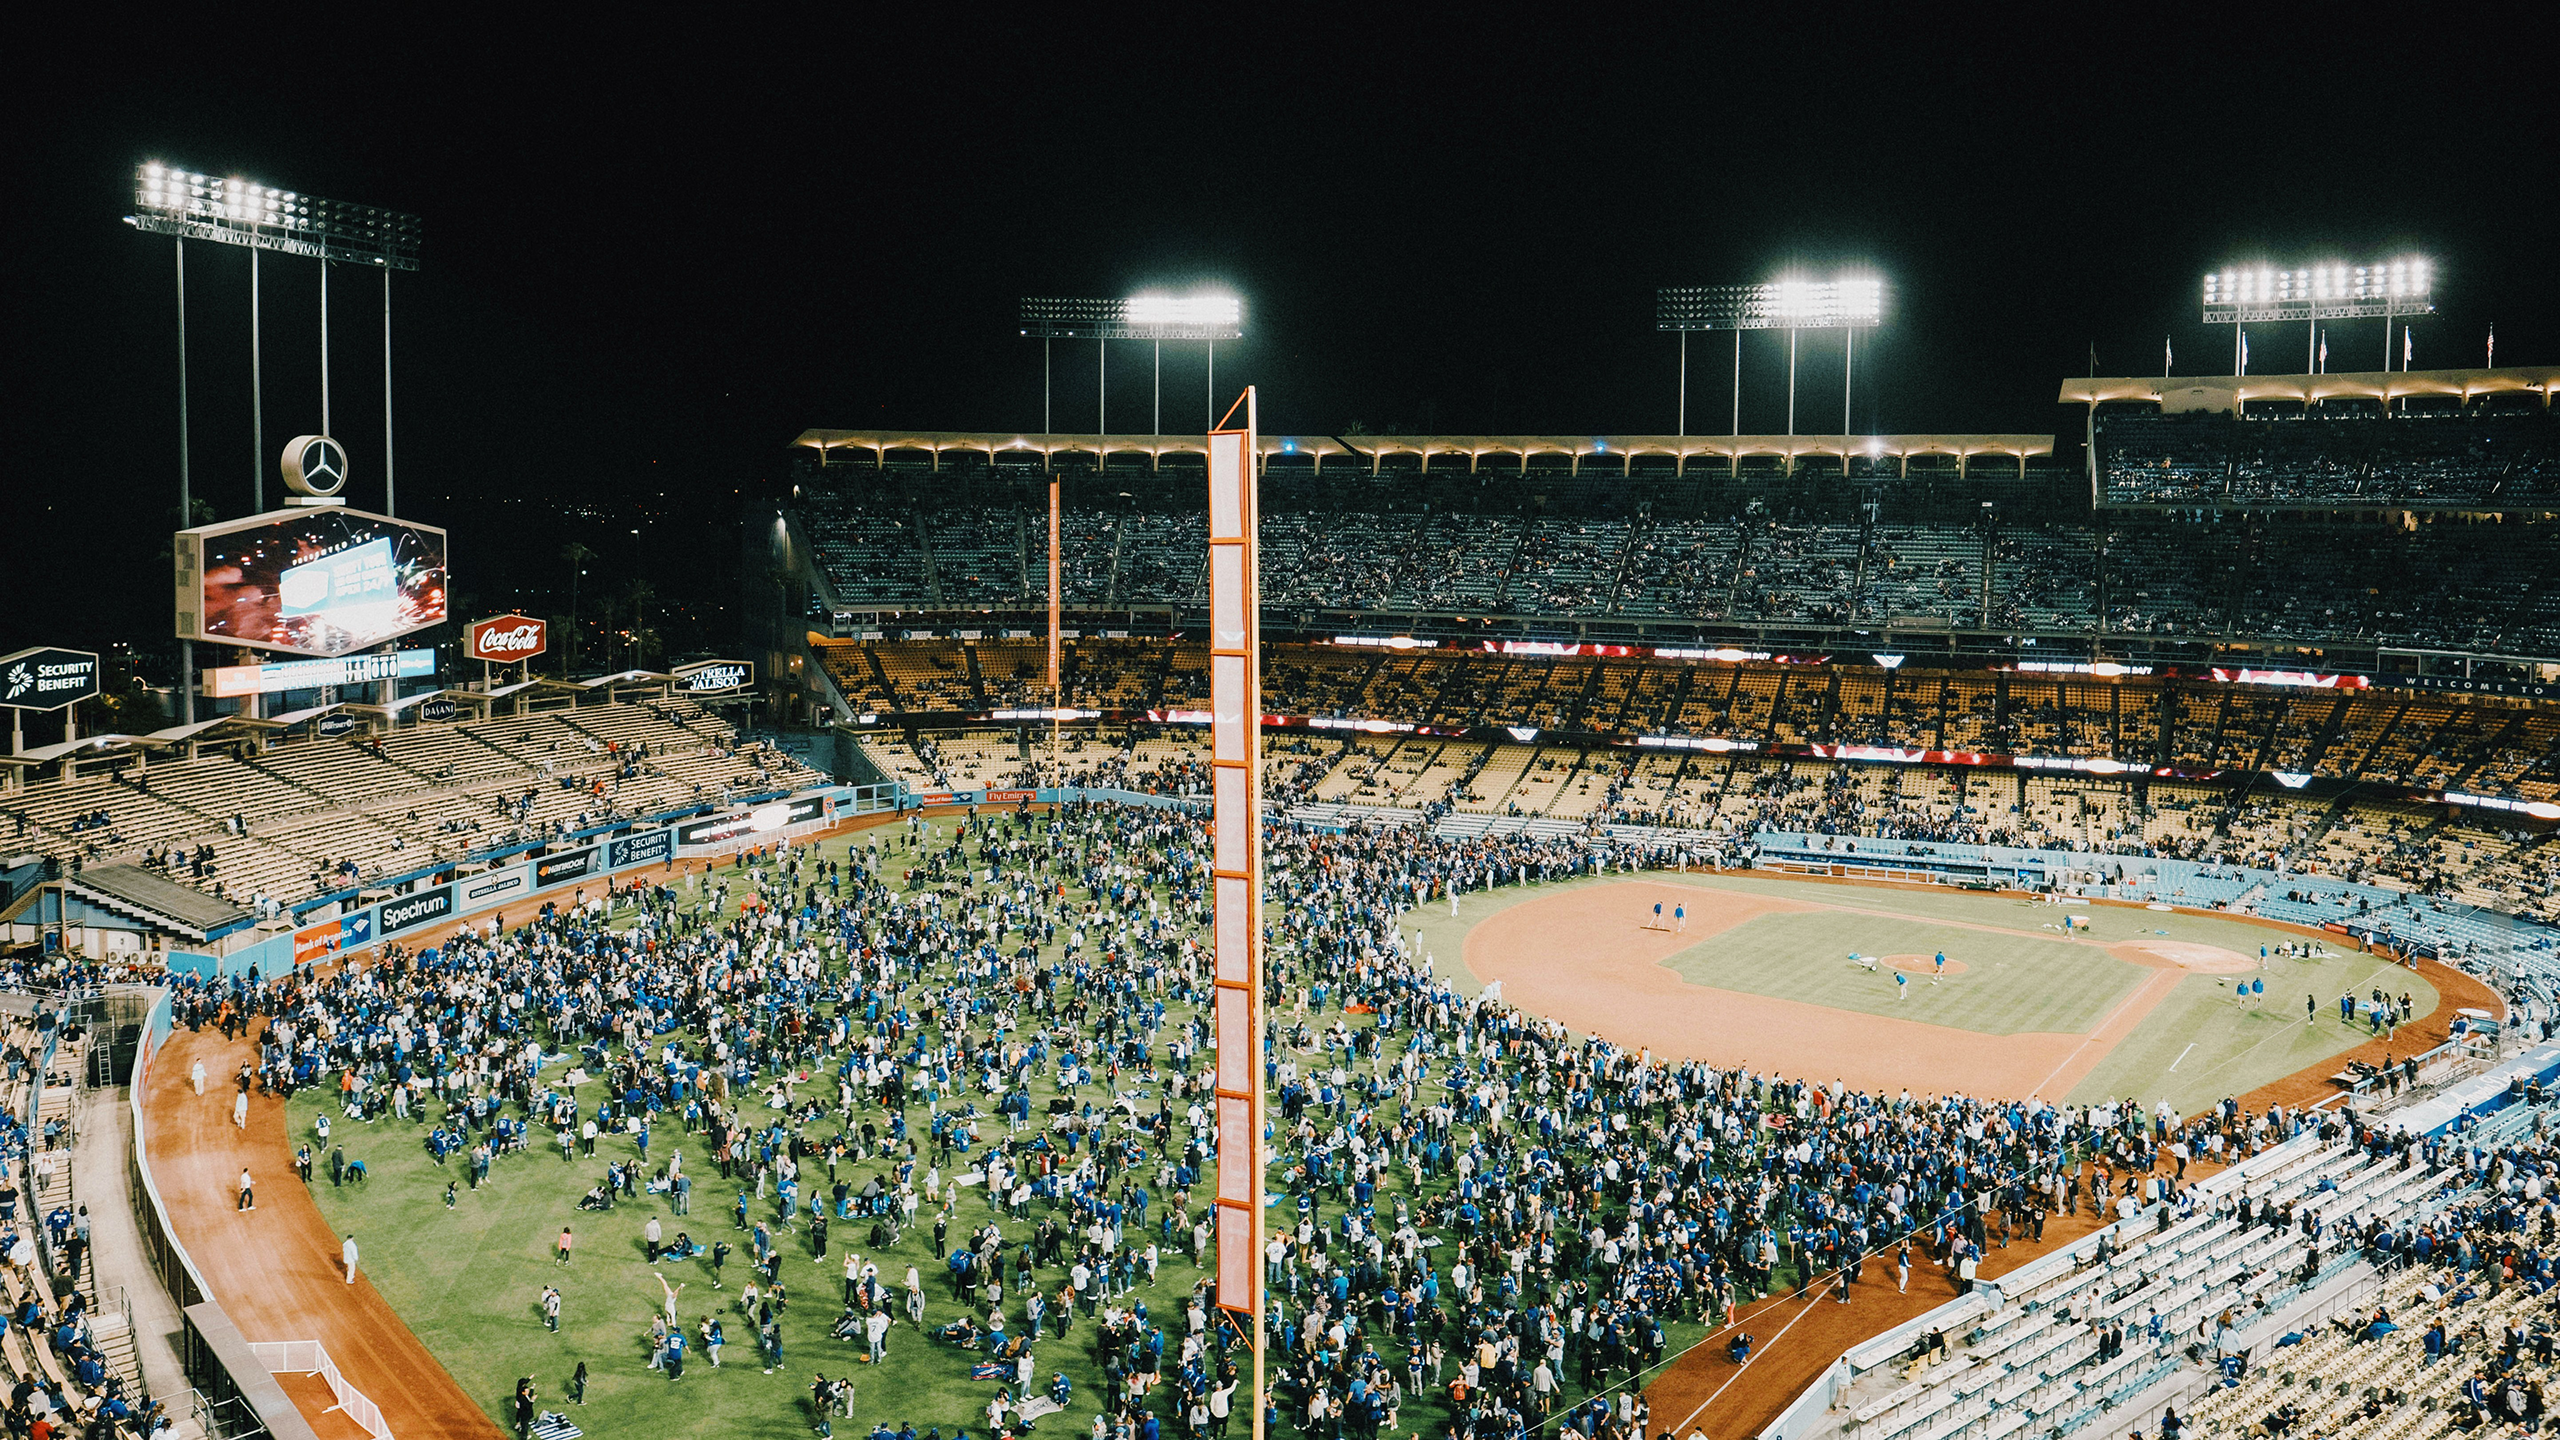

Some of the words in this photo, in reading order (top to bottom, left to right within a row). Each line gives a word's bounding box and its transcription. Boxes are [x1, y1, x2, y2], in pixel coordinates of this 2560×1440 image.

[479, 625, 540, 653] Coca-Cola
[37, 661, 93, 678] SECURITY
[685, 666, 745, 681] TRELLA
[37, 676, 87, 692] BENEFIT
[690, 676, 740, 691] JALISCO
[2405, 677, 2503, 692] WELCOME
[2521, 686, 2544, 695] TO
[425, 704, 454, 716] DASANI
[989, 792, 1001, 800] Fly
[631, 833, 667, 850] SECURITY
[631, 845, 662, 861] BENEFIT
[383, 896, 444, 928] Spectrum
[296, 939, 314, 954] Bank
[314, 935, 322, 947] of
